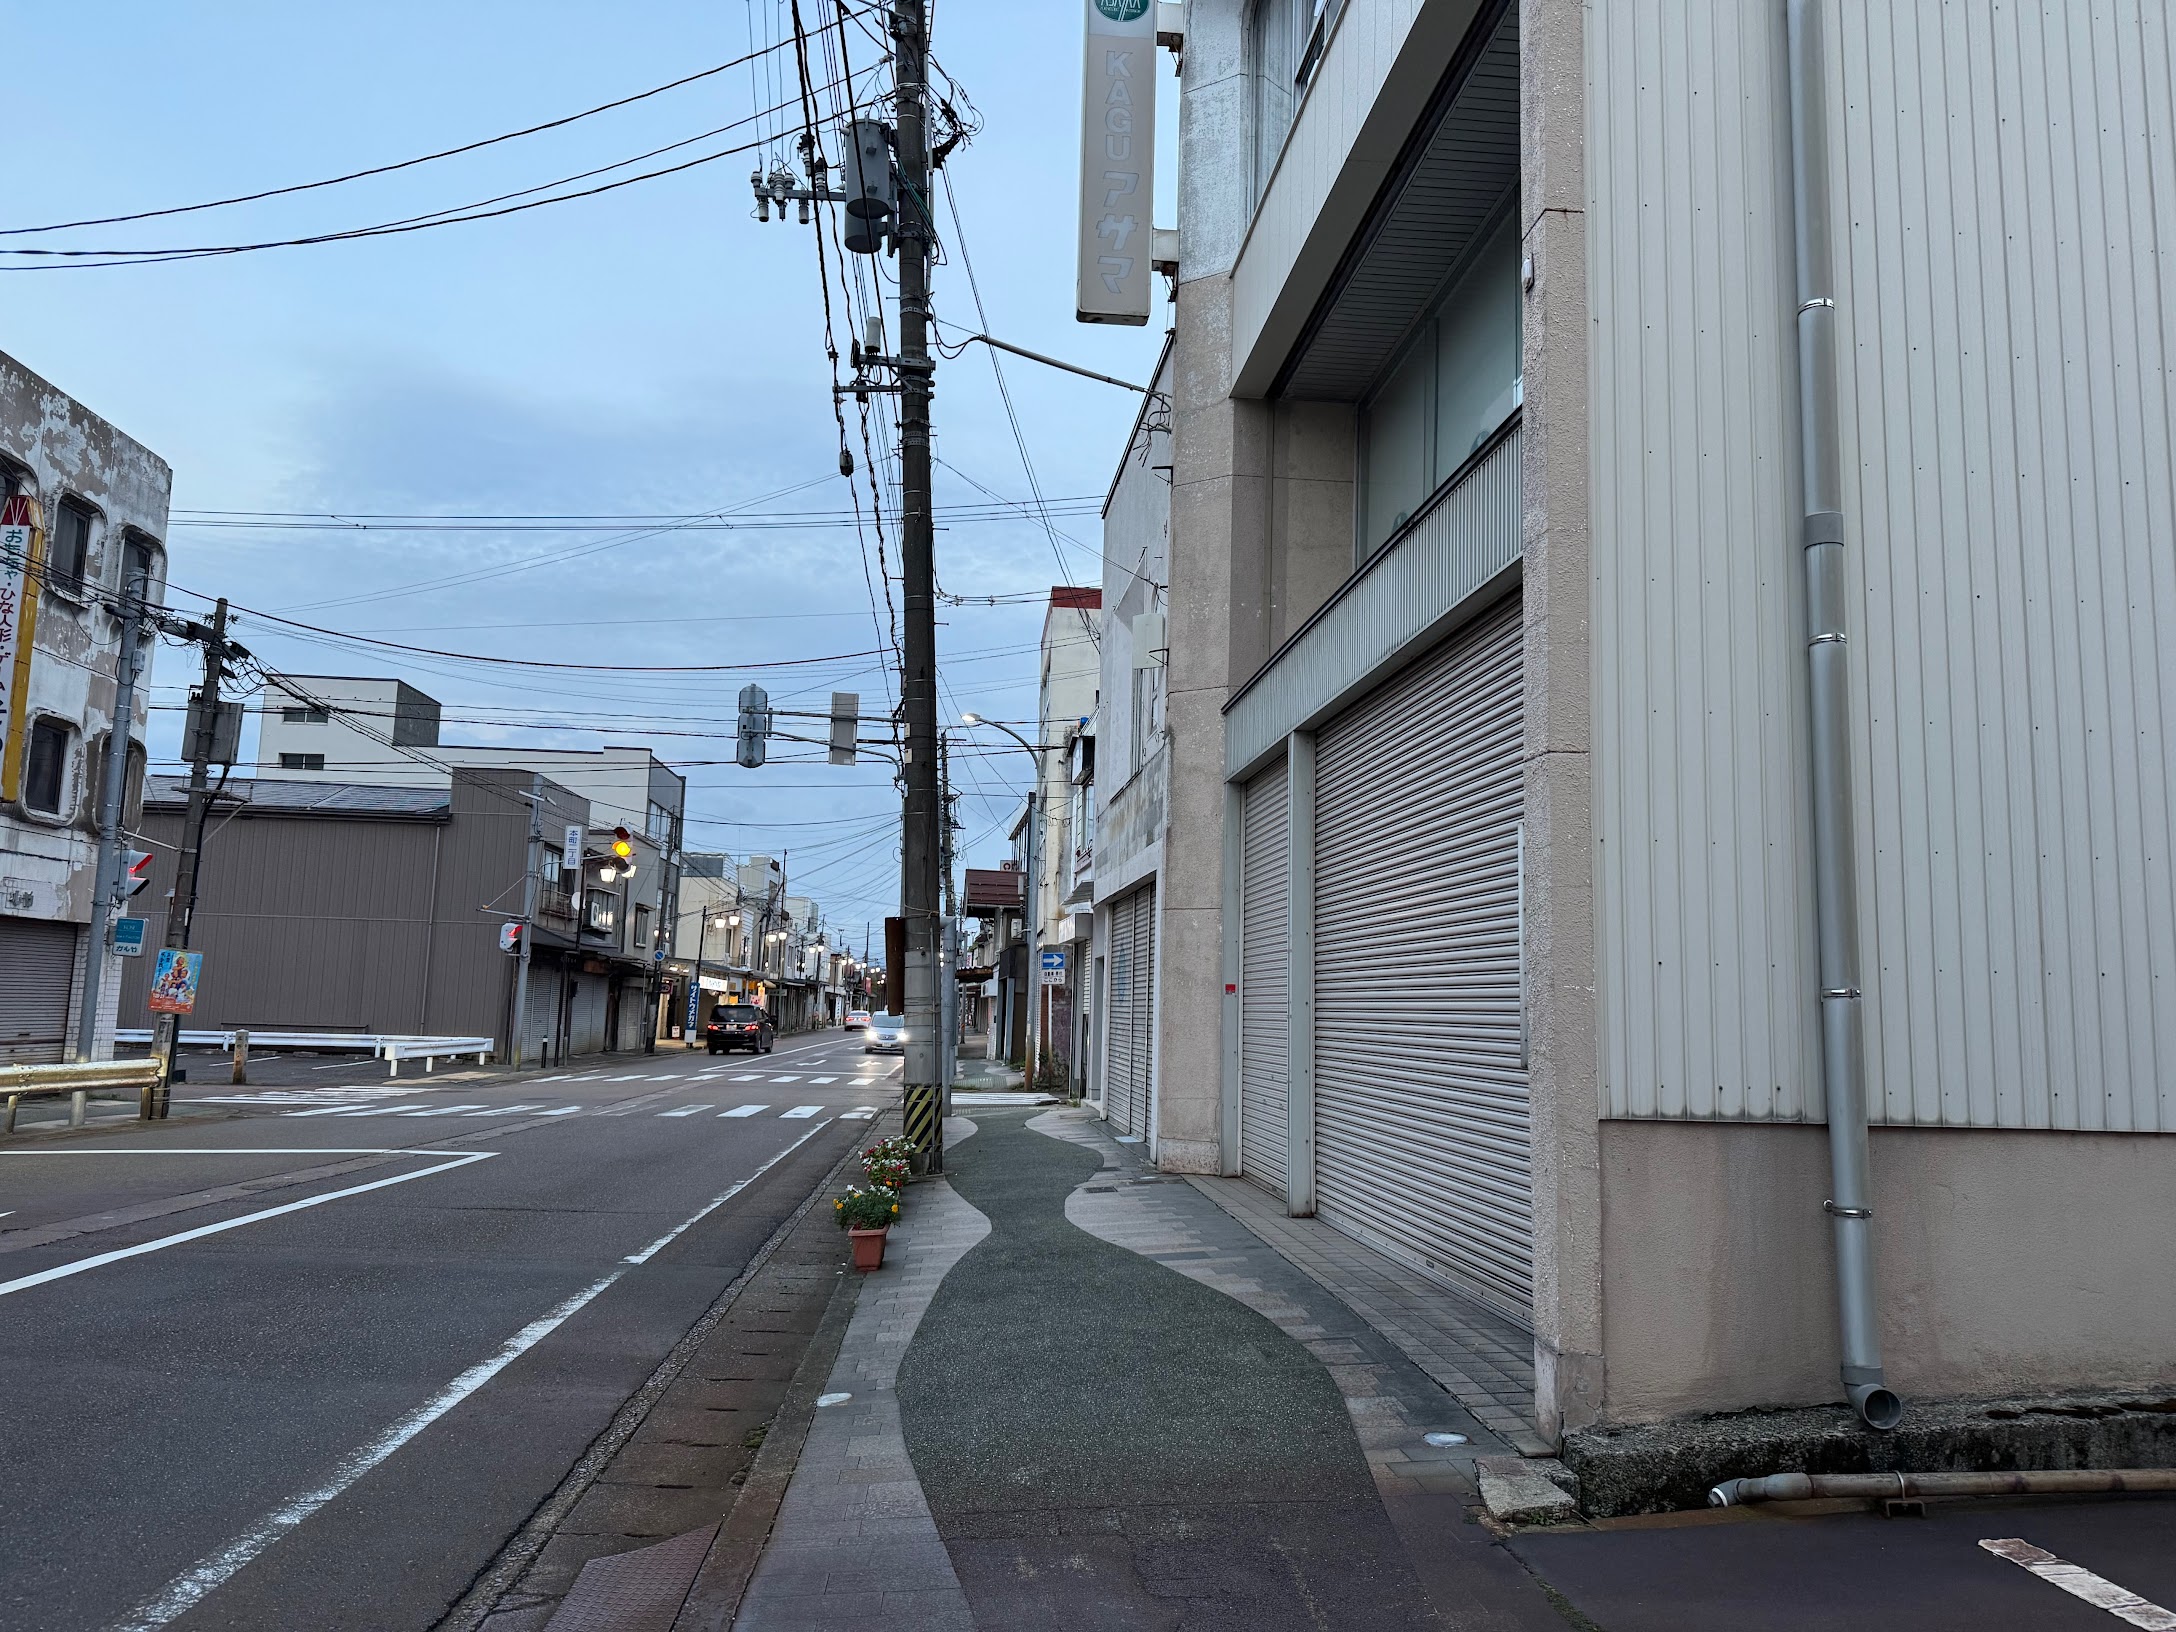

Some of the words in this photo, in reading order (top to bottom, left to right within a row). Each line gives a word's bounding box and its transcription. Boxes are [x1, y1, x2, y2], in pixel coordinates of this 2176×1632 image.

[1104, 50, 1134, 162] KAGU
[1095, 171, 1140, 294] アサマ
[567, 829, 579, 866] 本町二丁目
